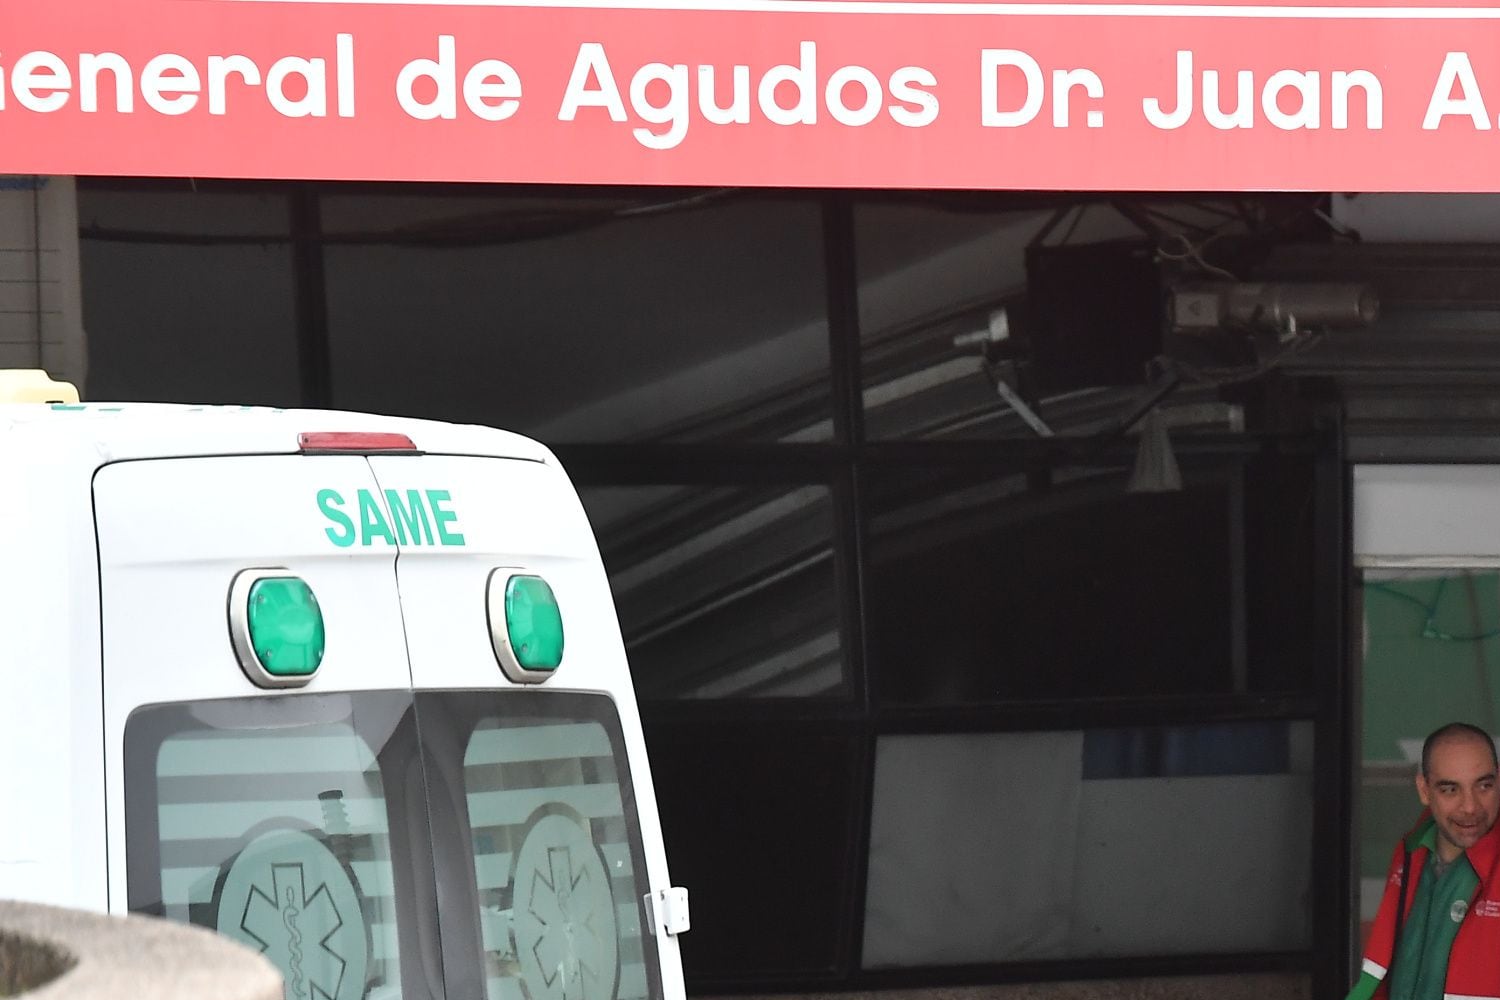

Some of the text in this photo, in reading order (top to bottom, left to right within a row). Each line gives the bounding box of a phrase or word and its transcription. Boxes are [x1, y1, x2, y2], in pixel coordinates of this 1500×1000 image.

[0, 34, 354, 118] eneral
[396, 35, 522, 121] de
[557, 41, 939, 150] Agudos
[981, 49, 1104, 127] Dr.
[1143, 50, 1383, 130] Juan
[315, 488, 466, 548] SAME
